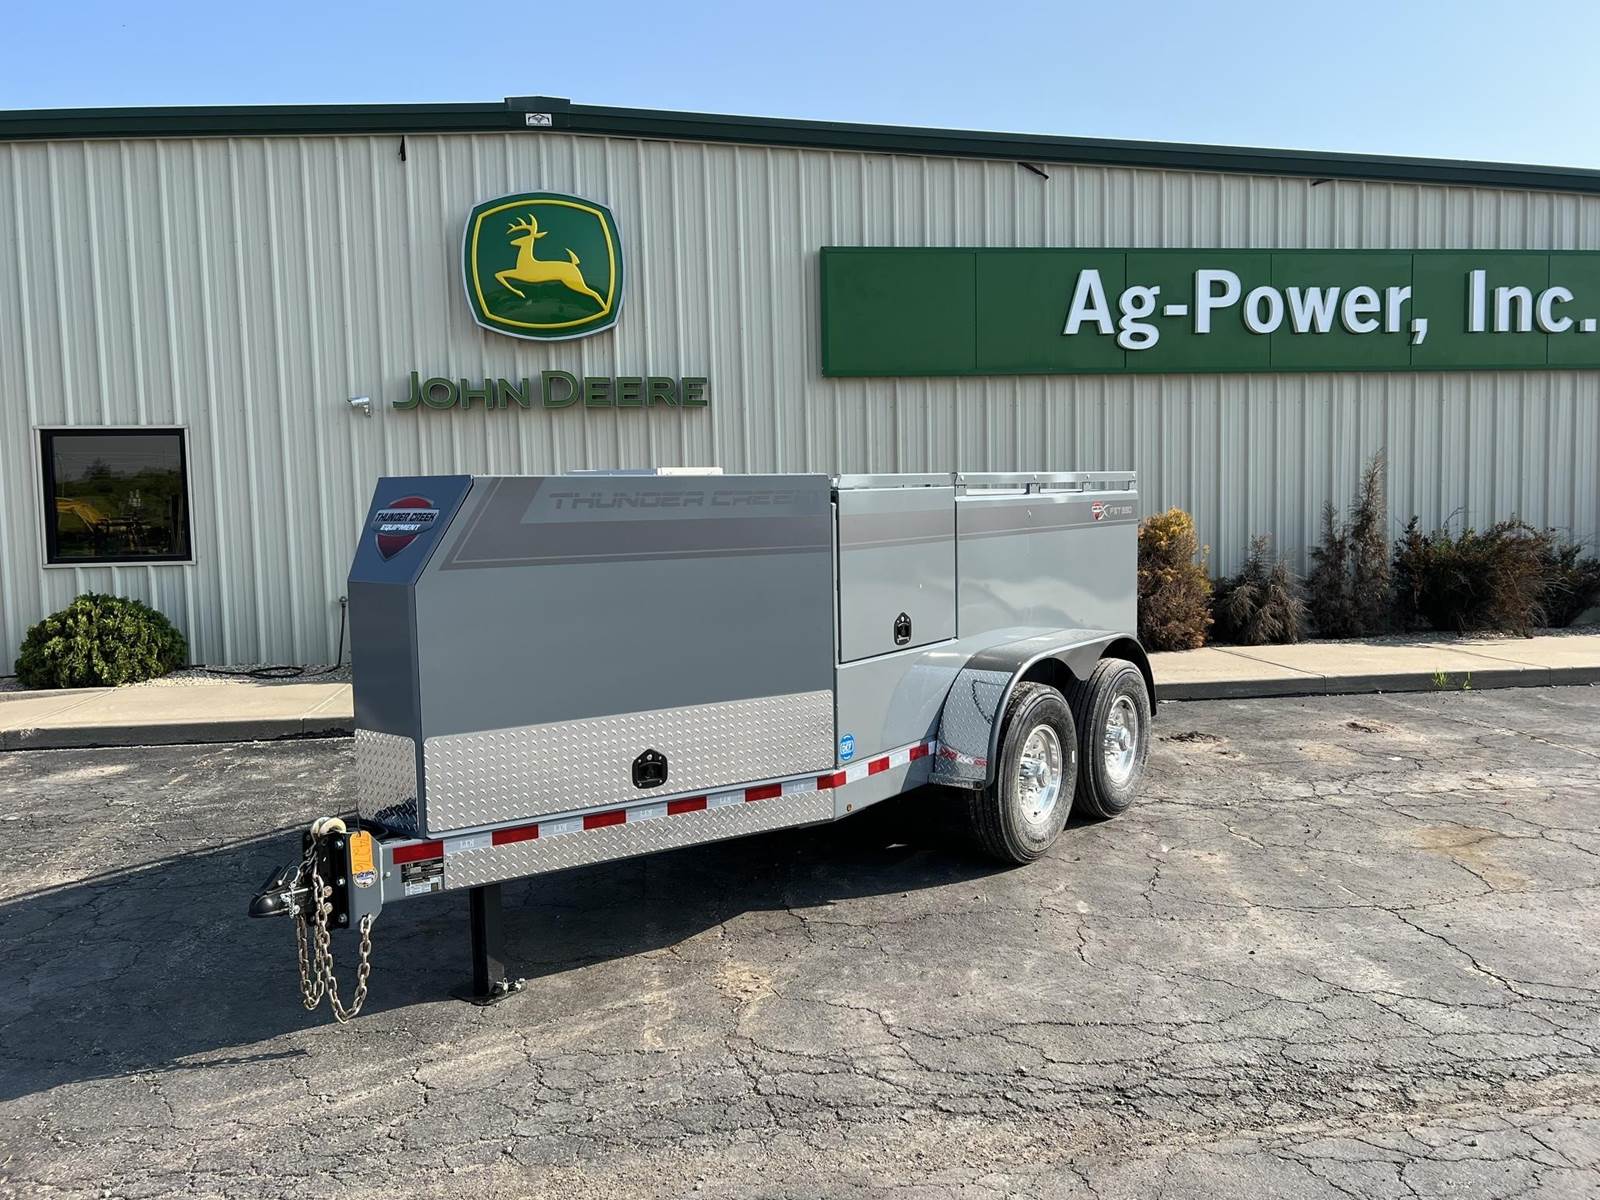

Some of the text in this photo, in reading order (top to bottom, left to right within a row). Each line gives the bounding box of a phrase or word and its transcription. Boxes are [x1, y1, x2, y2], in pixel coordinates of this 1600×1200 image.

[1063, 269, 1597, 350] Ag-Power, Inc.
[393, 370, 708, 410] JOHN DEERE
[549, 492, 704, 509] THUNDER
[375, 513, 438, 522] THUNDER CREEK
